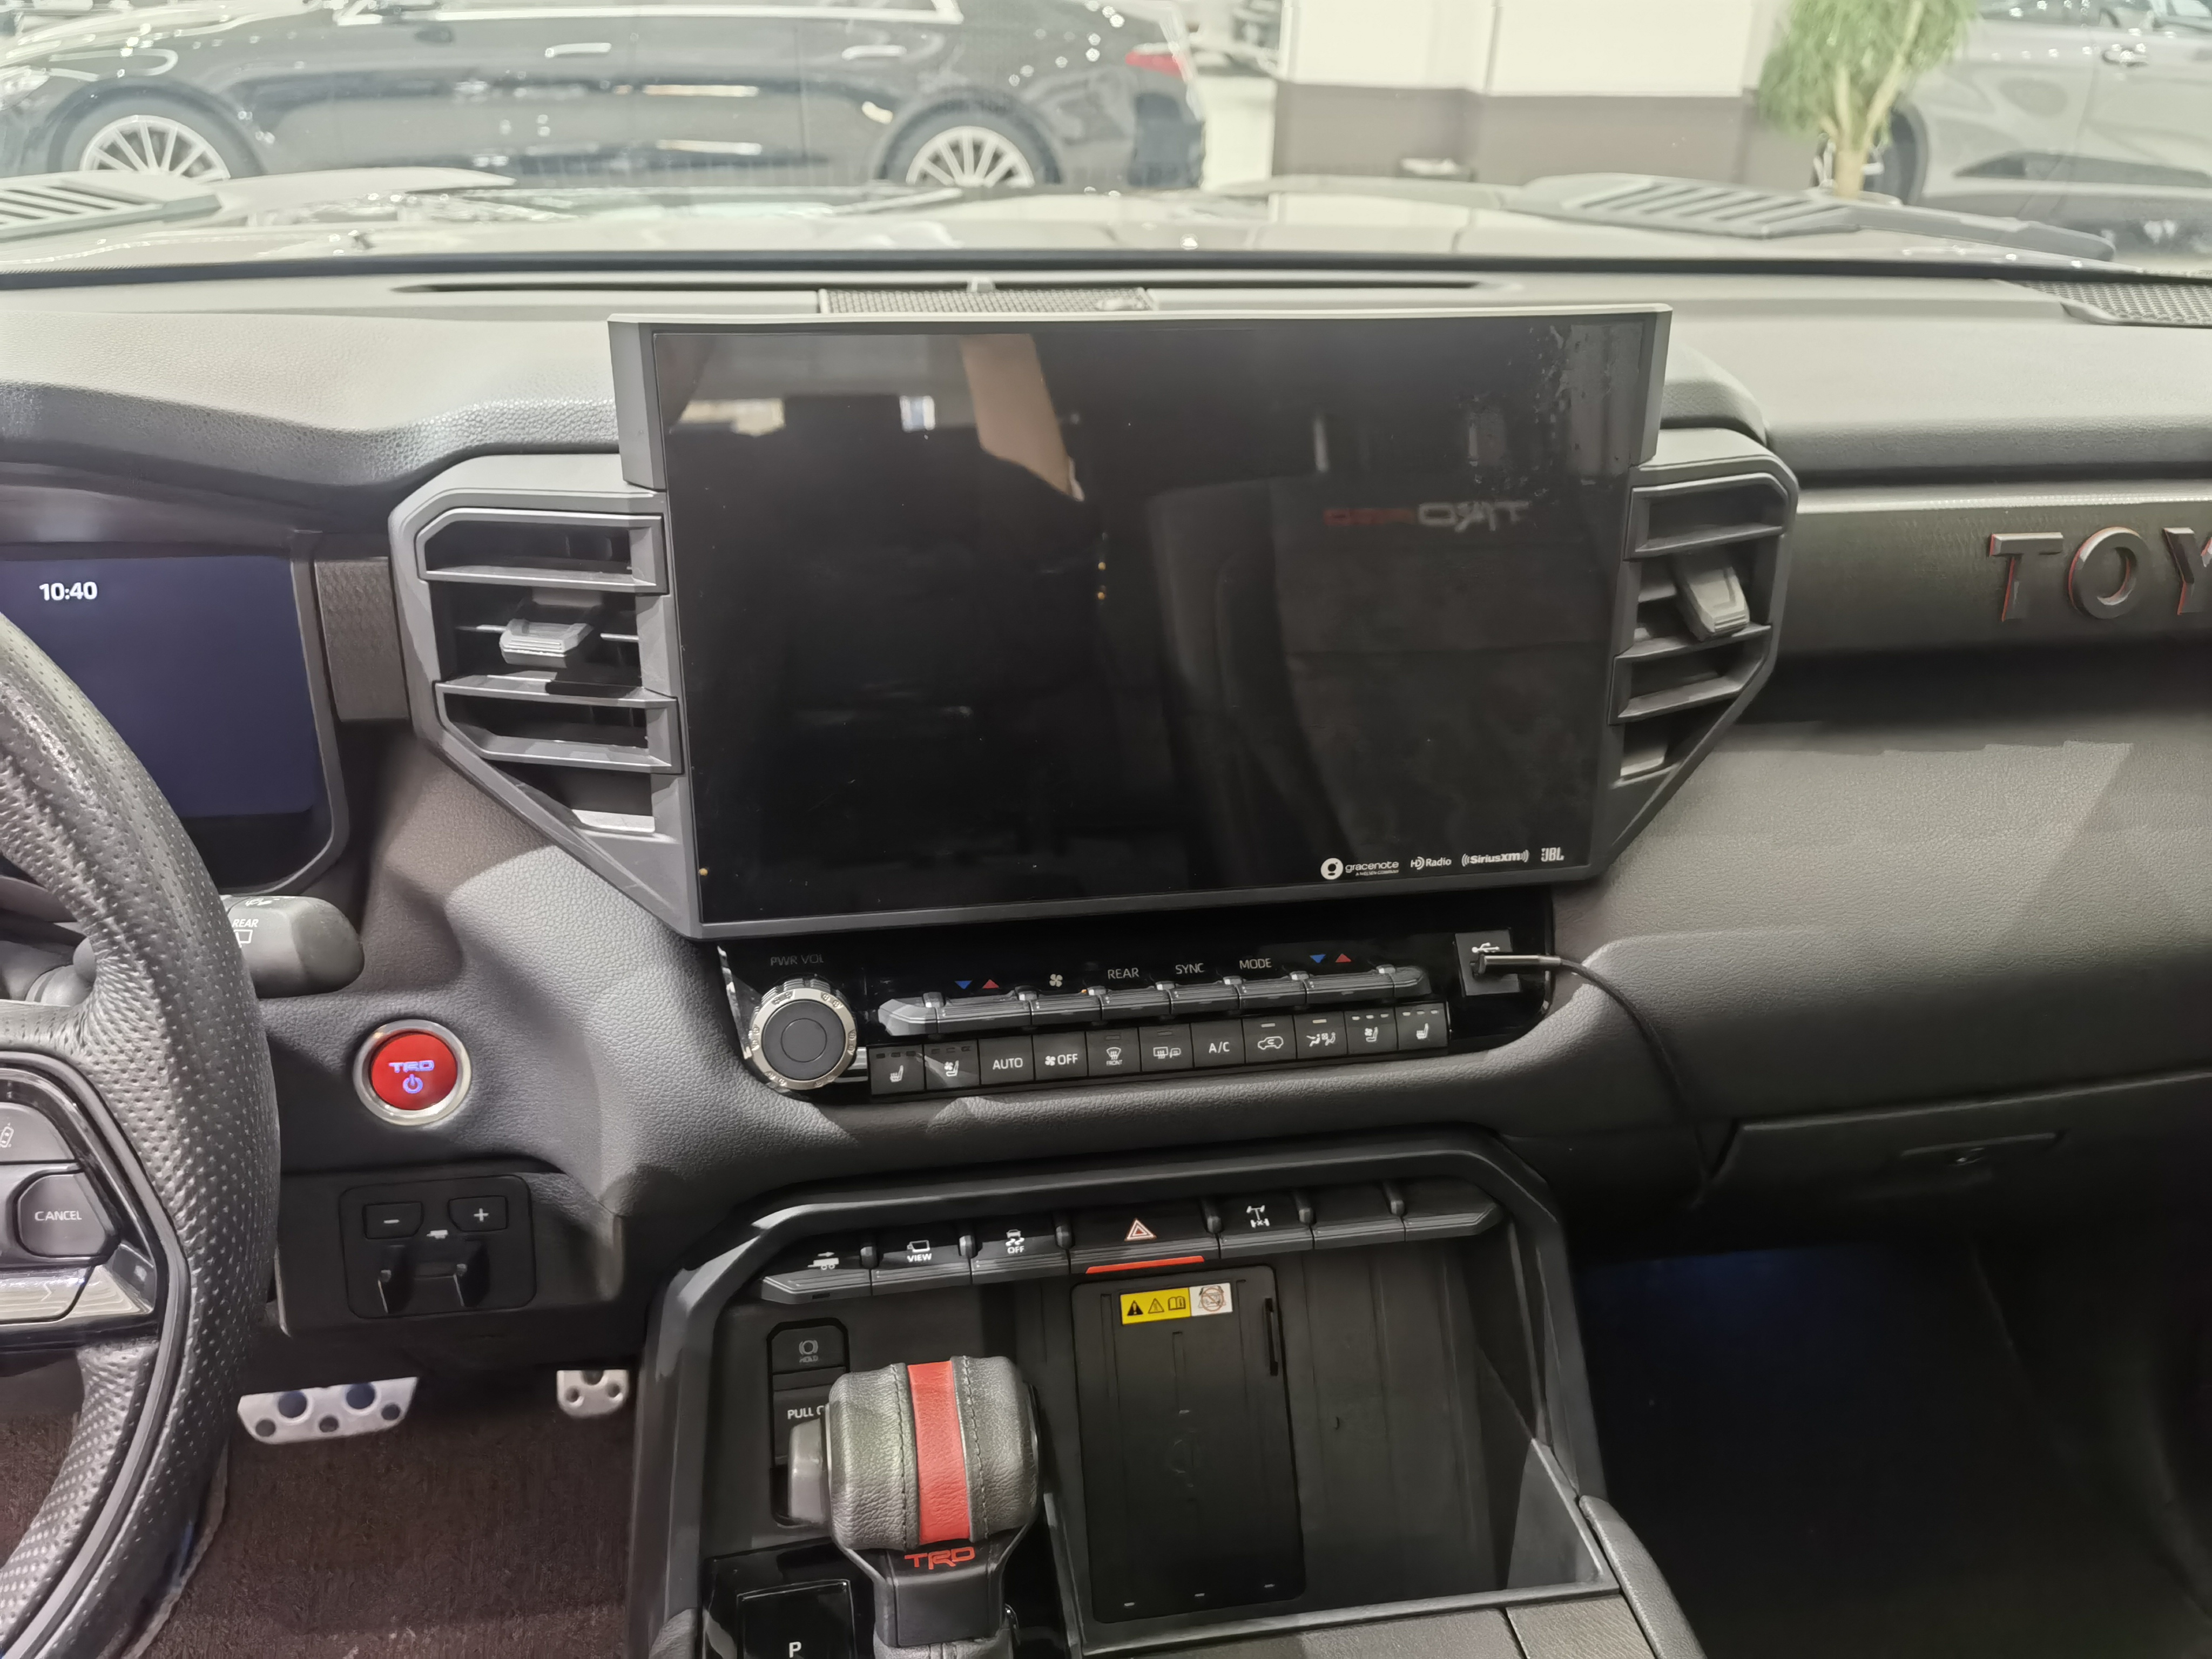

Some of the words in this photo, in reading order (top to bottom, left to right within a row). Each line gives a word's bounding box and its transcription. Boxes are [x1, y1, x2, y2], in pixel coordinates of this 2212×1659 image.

[39, 581, 98, 601] 10:40
[1541, 846, 1564, 862] JBL
[1345, 861, 1400, 873] gracenote
[1410, 856, 1425, 870] HD
[1426, 857, 1452, 867] Radio
[232, 918, 259, 928] REAR
[770, 955, 798, 967] PWR
[801, 953, 824, 965] VOL
[1239, 957, 1272, 970] MODE
[1107, 967, 1139, 980] REAR
[1175, 962, 1205, 975] SYNC
[1208, 1040, 1230, 1055] A/C
[388, 1060, 435, 1073] TRD
[992, 1056, 1023, 1070] AUTO
[1057, 1053, 1078, 1067] OFF
[34, 1210, 82, 1222] CANCEL
[1007, 1245, 1025, 1255] OFF
[907, 1252, 932, 1263] VIEW
[787, 1407, 814, 1420] PULL
[904, 1546, 975, 1570] TRD
[788, 1641, 802, 1658] P
